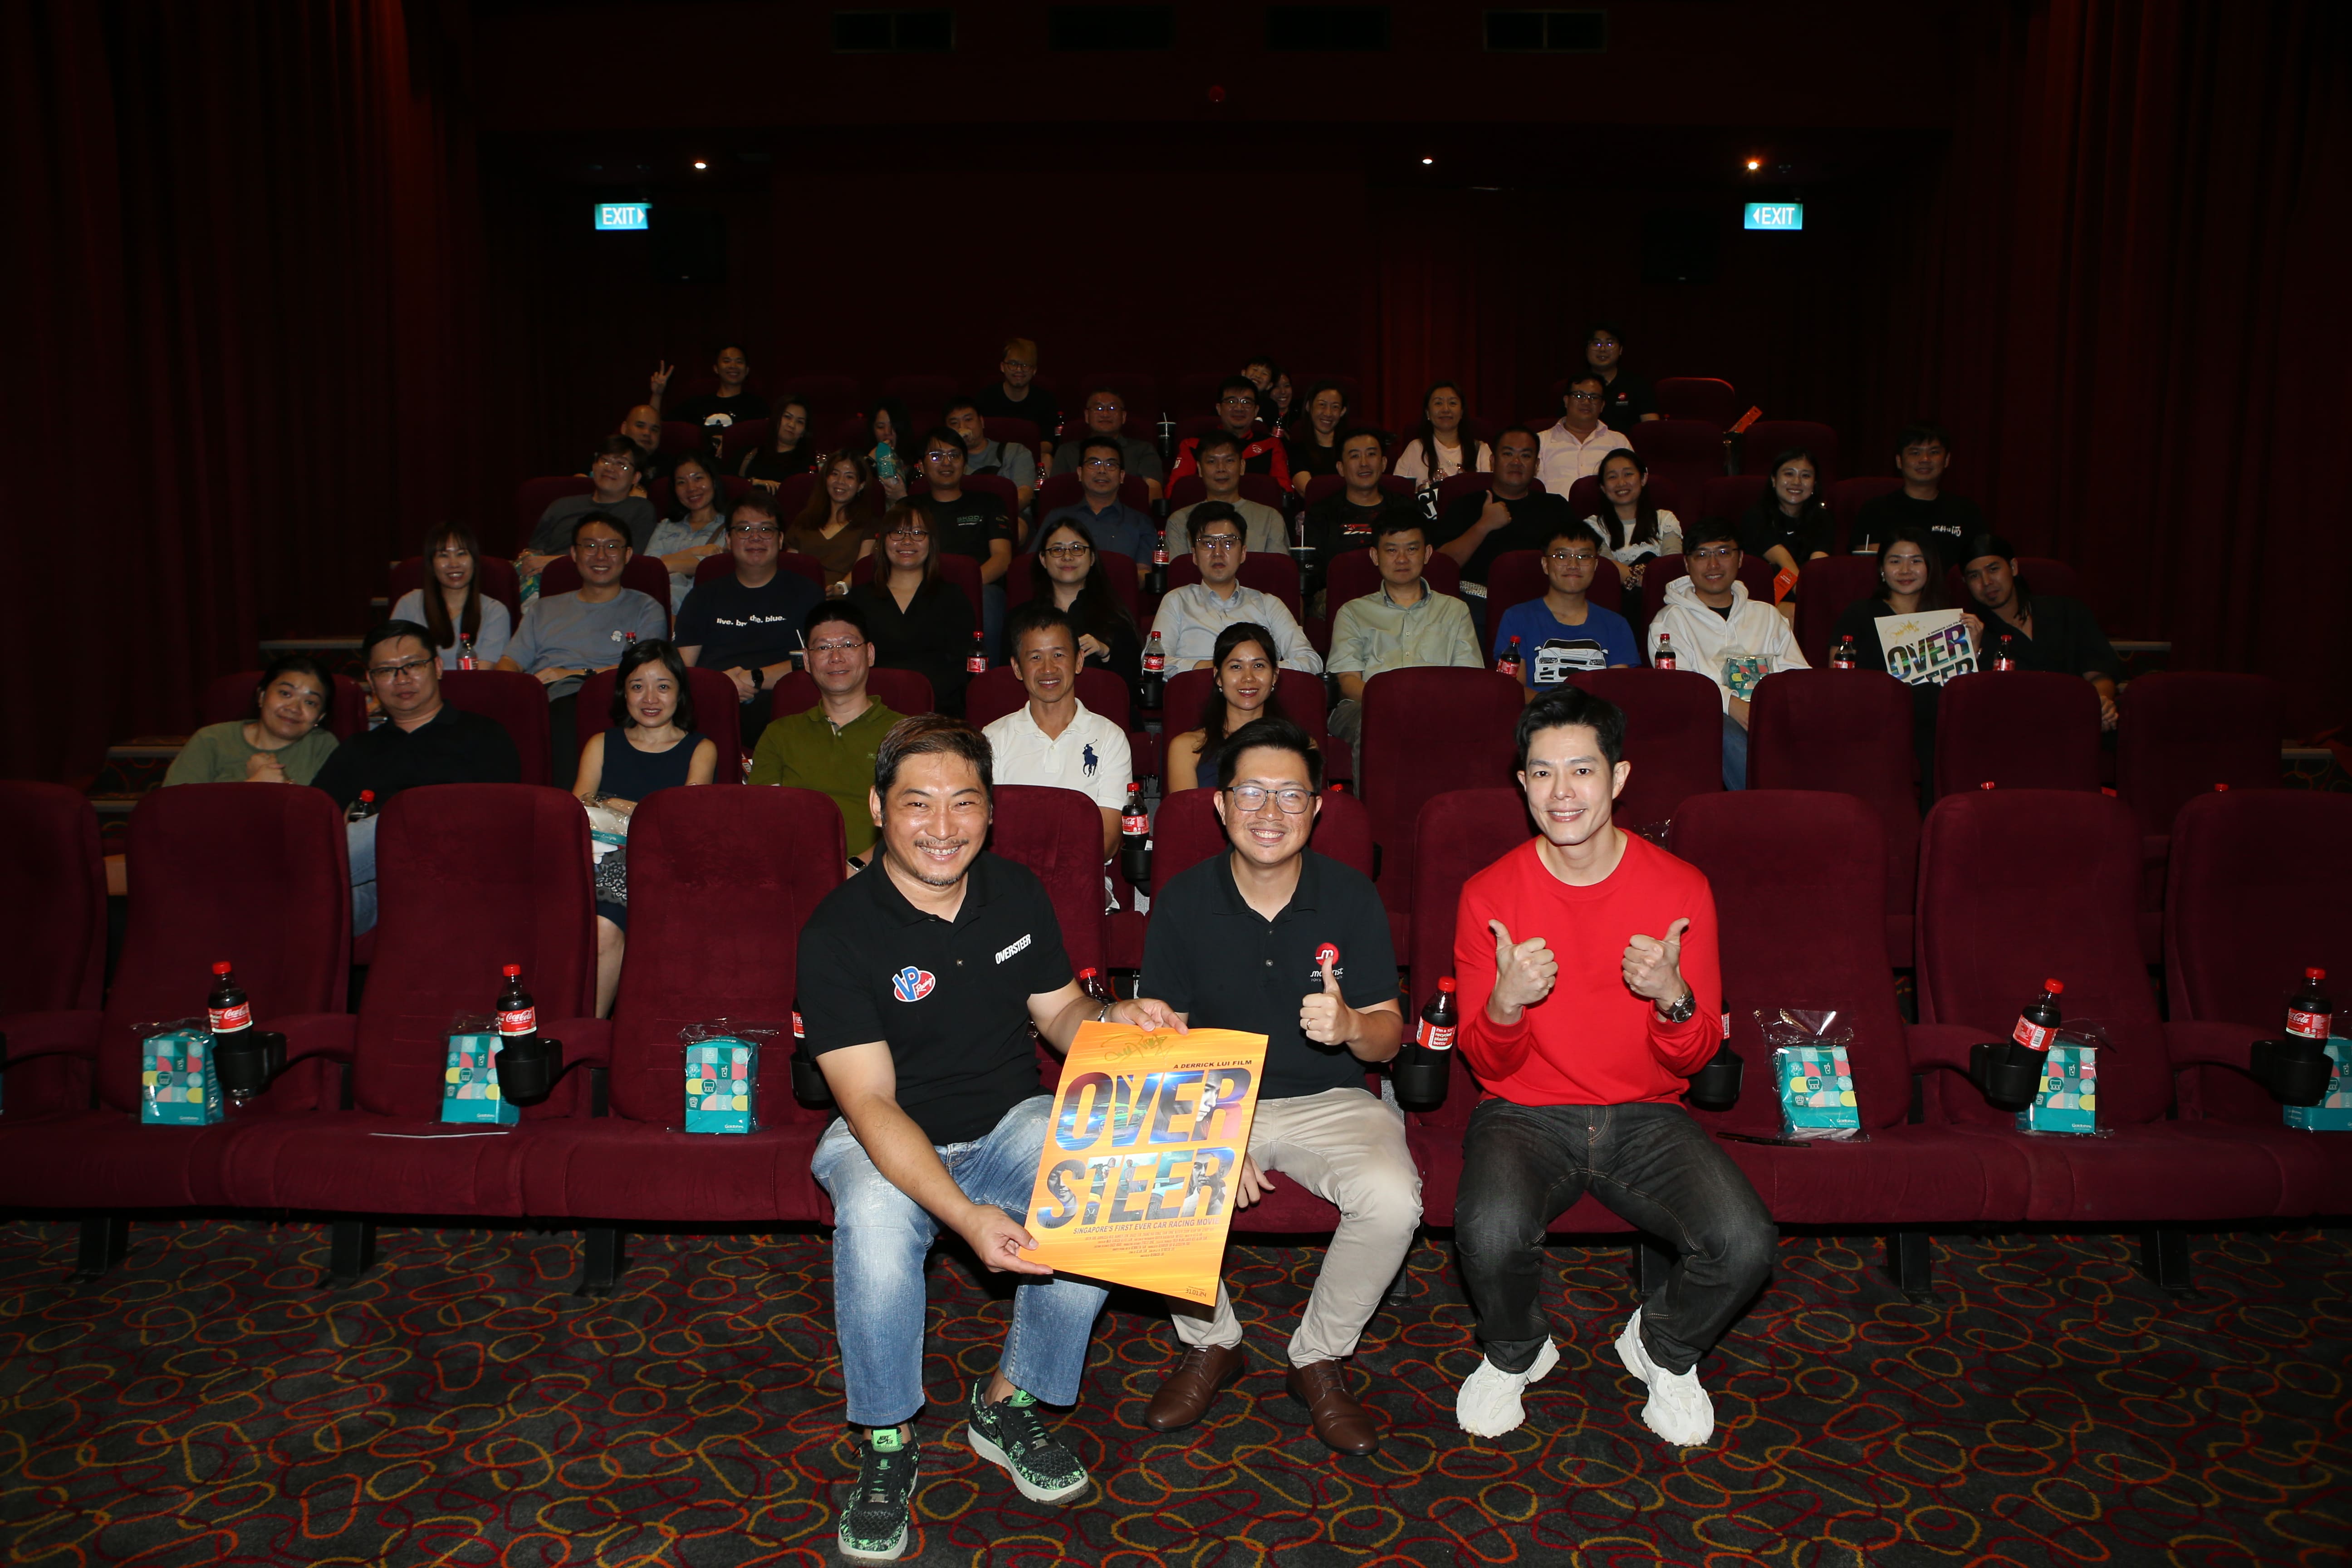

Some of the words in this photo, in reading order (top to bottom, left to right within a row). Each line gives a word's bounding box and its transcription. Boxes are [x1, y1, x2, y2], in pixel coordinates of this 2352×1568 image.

[602, 207, 636, 225] EXIT
[1762, 207, 1795, 225] EXIT
[1887, 624, 1970, 680] OVER
[995, 933, 1031, 965] OVERSTEER
[893, 967, 919, 1000] VP
[916, 977, 933, 995] Racing
[506, 1010, 532, 1023] Coca-Cola
[1055, 1068, 1251, 1151] OVER
[1037, 1146, 1234, 1229] STEER
[1073, 1225, 1113, 1234] SINGAPORE'S
[1169, 1220, 1195, 1228] RACING
[1197, 1217, 1220, 1225] MOVIE
